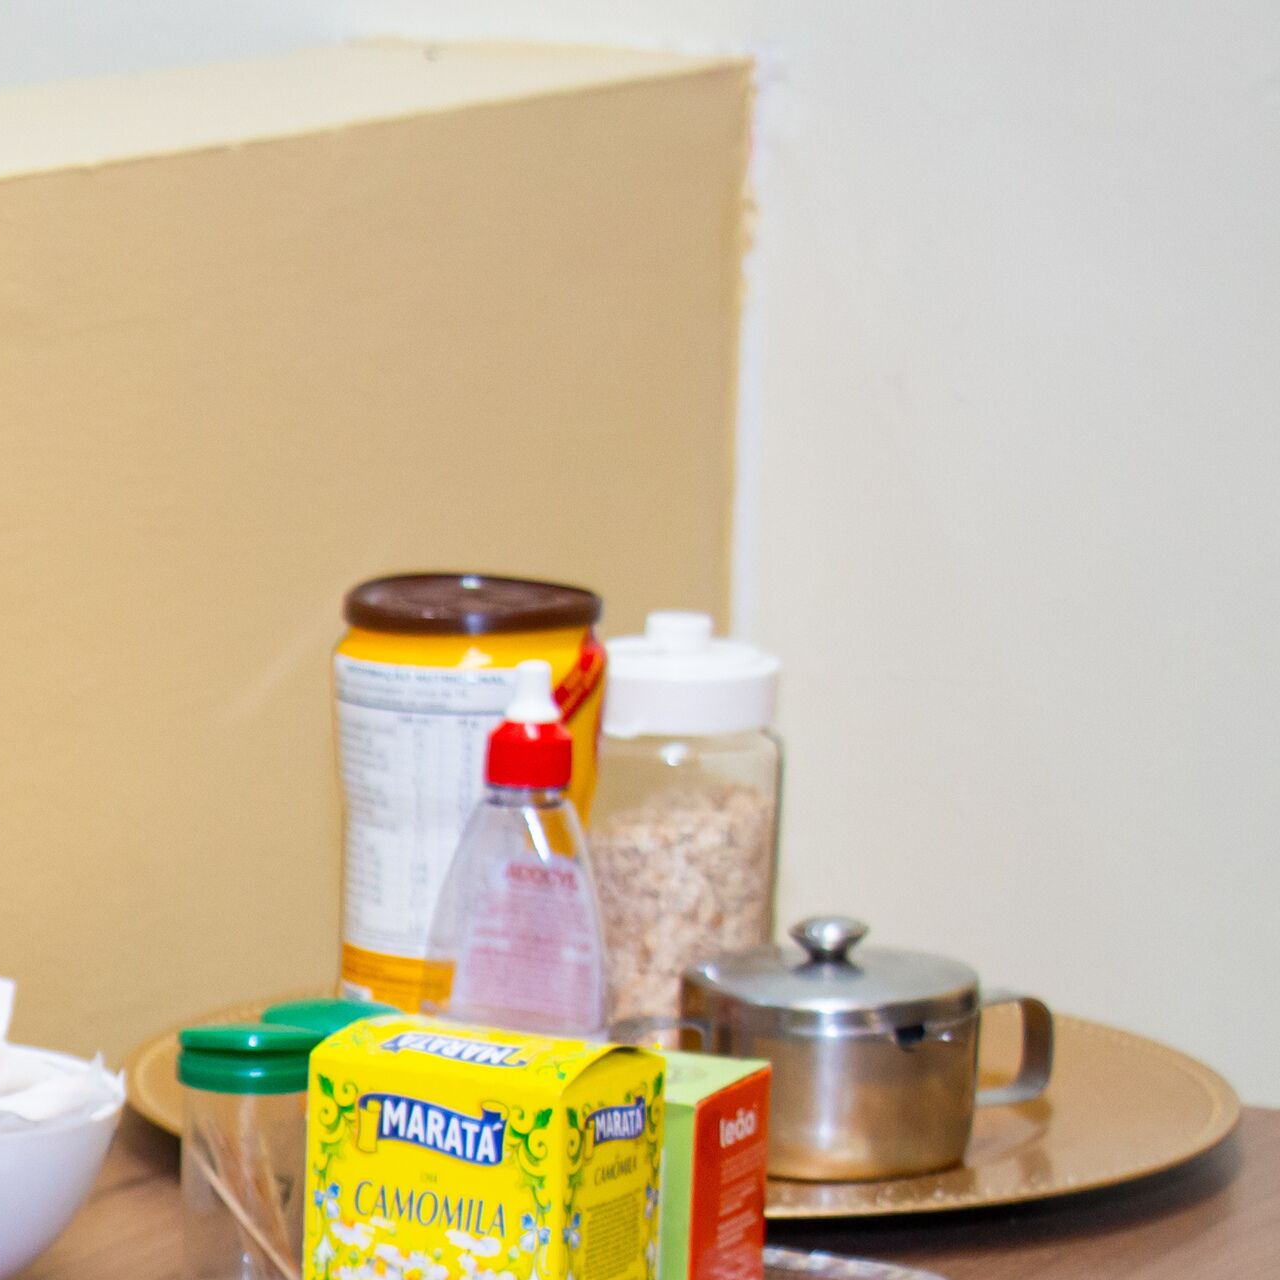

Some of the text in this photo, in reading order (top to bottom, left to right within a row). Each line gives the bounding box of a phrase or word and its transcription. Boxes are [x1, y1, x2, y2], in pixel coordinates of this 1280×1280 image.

[382, 1098, 503, 1164] MARATÁ
[595, 1104, 643, 1141] MARATÁ
[353, 1180, 507, 1238] CAMOMILA
